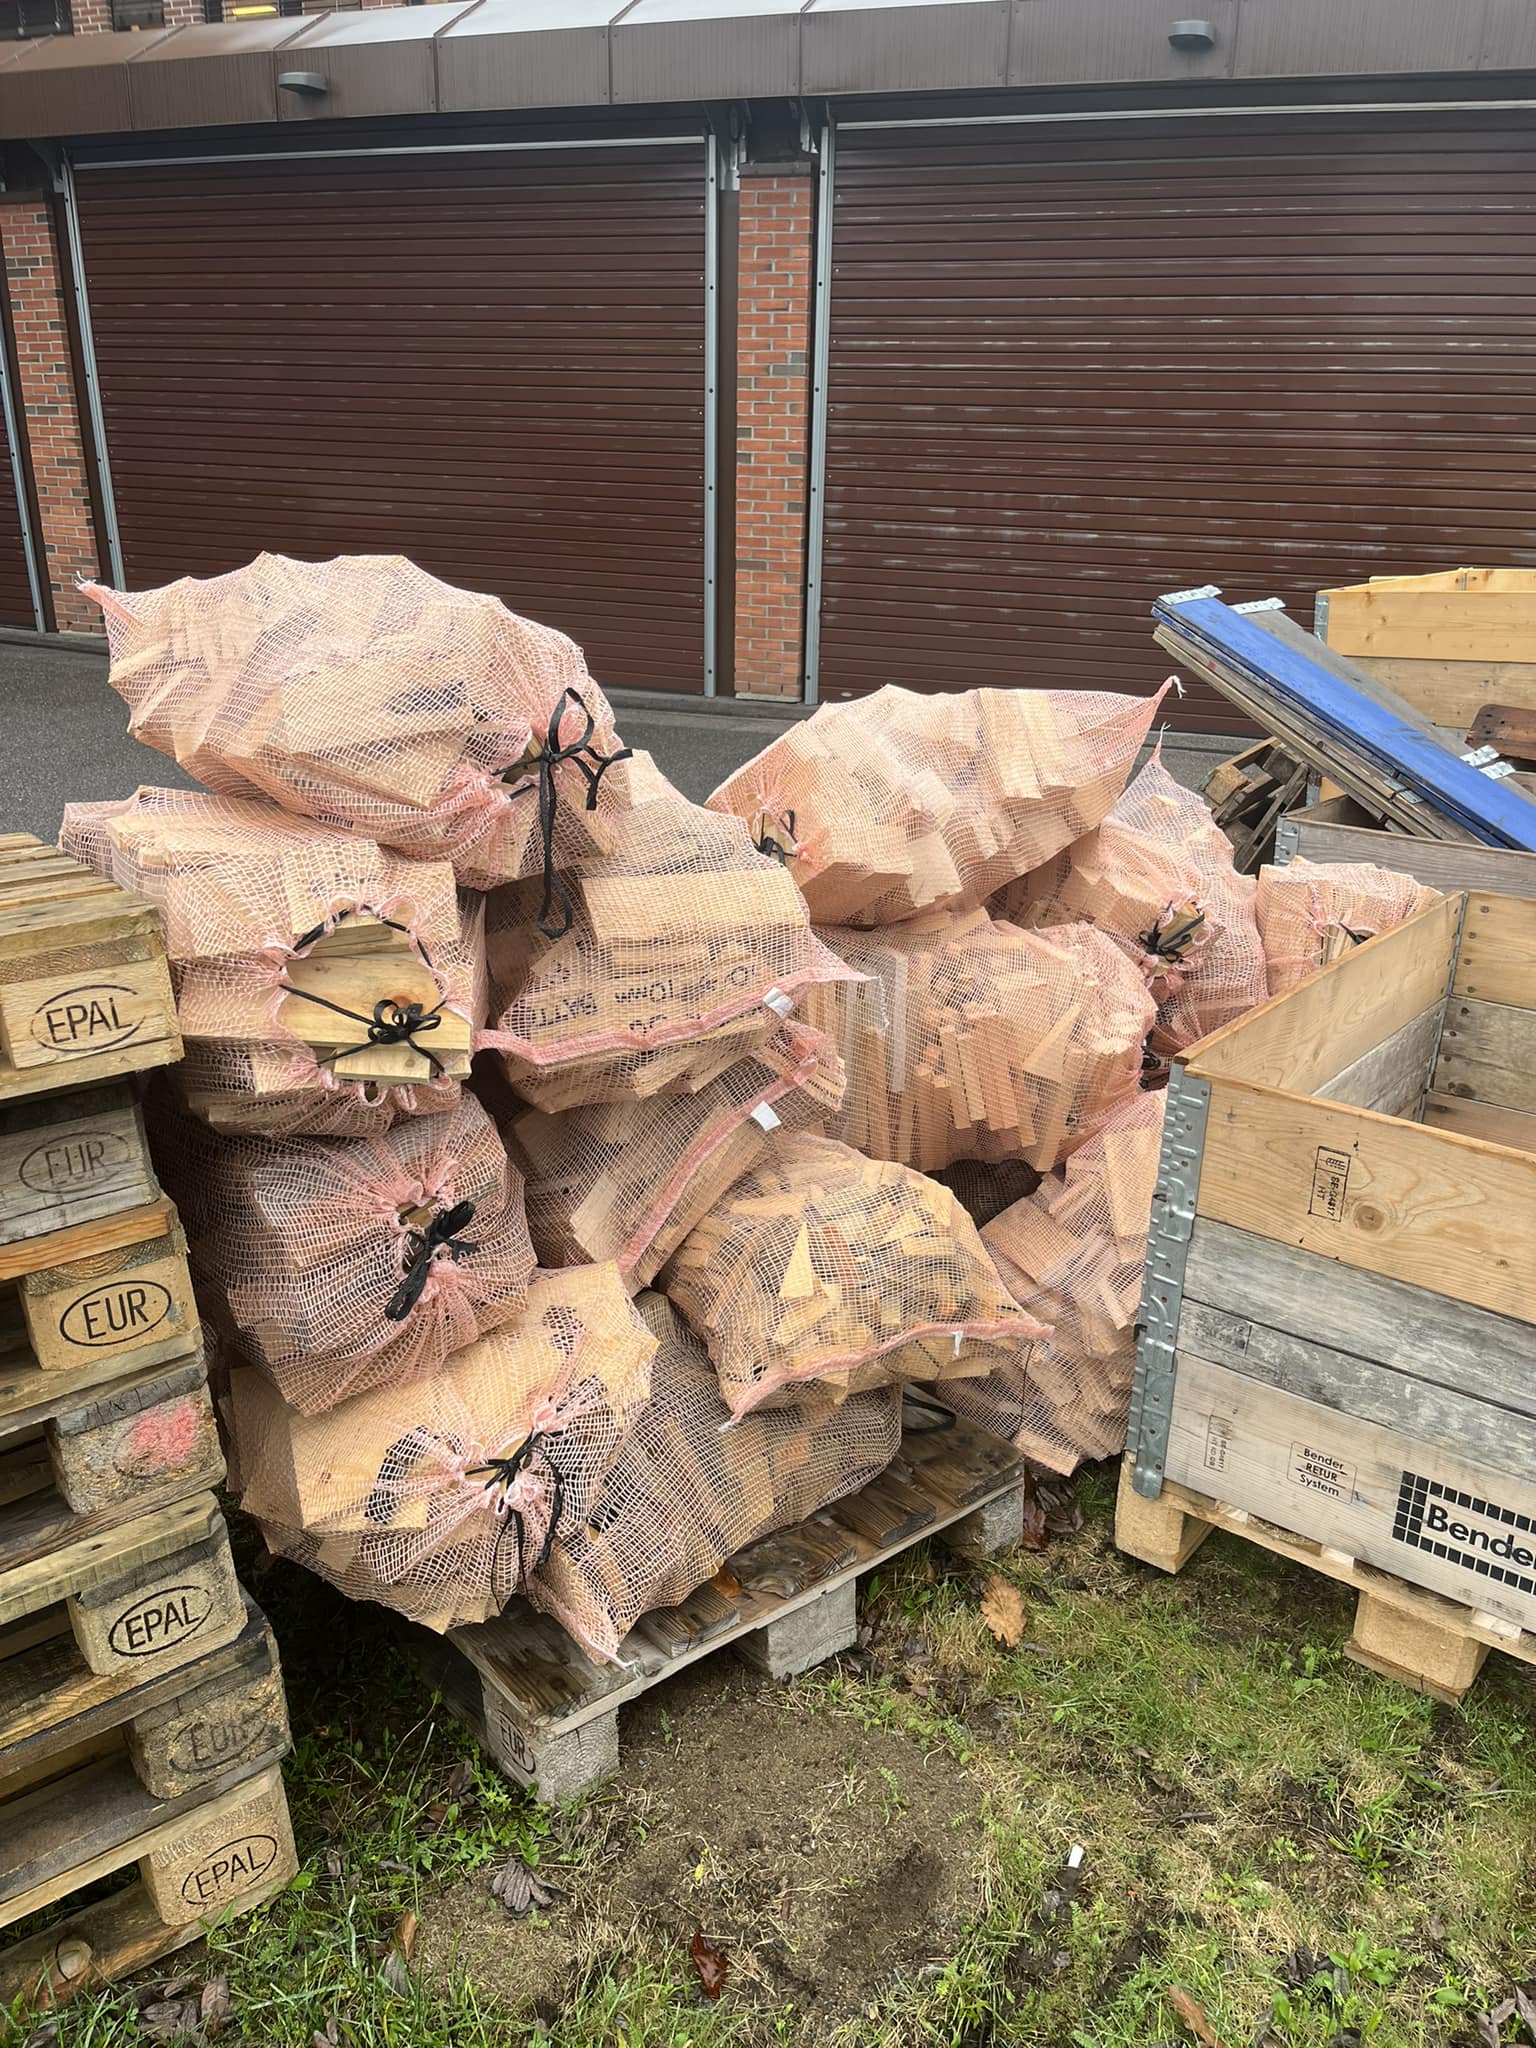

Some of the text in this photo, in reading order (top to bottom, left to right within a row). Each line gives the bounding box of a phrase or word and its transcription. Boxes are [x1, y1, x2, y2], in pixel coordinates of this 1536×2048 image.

[45, 997, 132, 1043] EPAL
[45, 1140, 105, 1185] EUR
[1317, 1185, 1326, 1201] HT
[82, 1288, 149, 1339] EUR
[1303, 1447, 1344, 1470] Bender
[1305, 1462, 1338, 1482] RETUR
[1299, 1474, 1339, 1497] System
[1427, 1503, 1536, 1567] Bende
[125, 1596, 201, 1650] EPAL
[500, 1719, 527, 1767] EUR
[195, 1846, 266, 1898] EPAL
